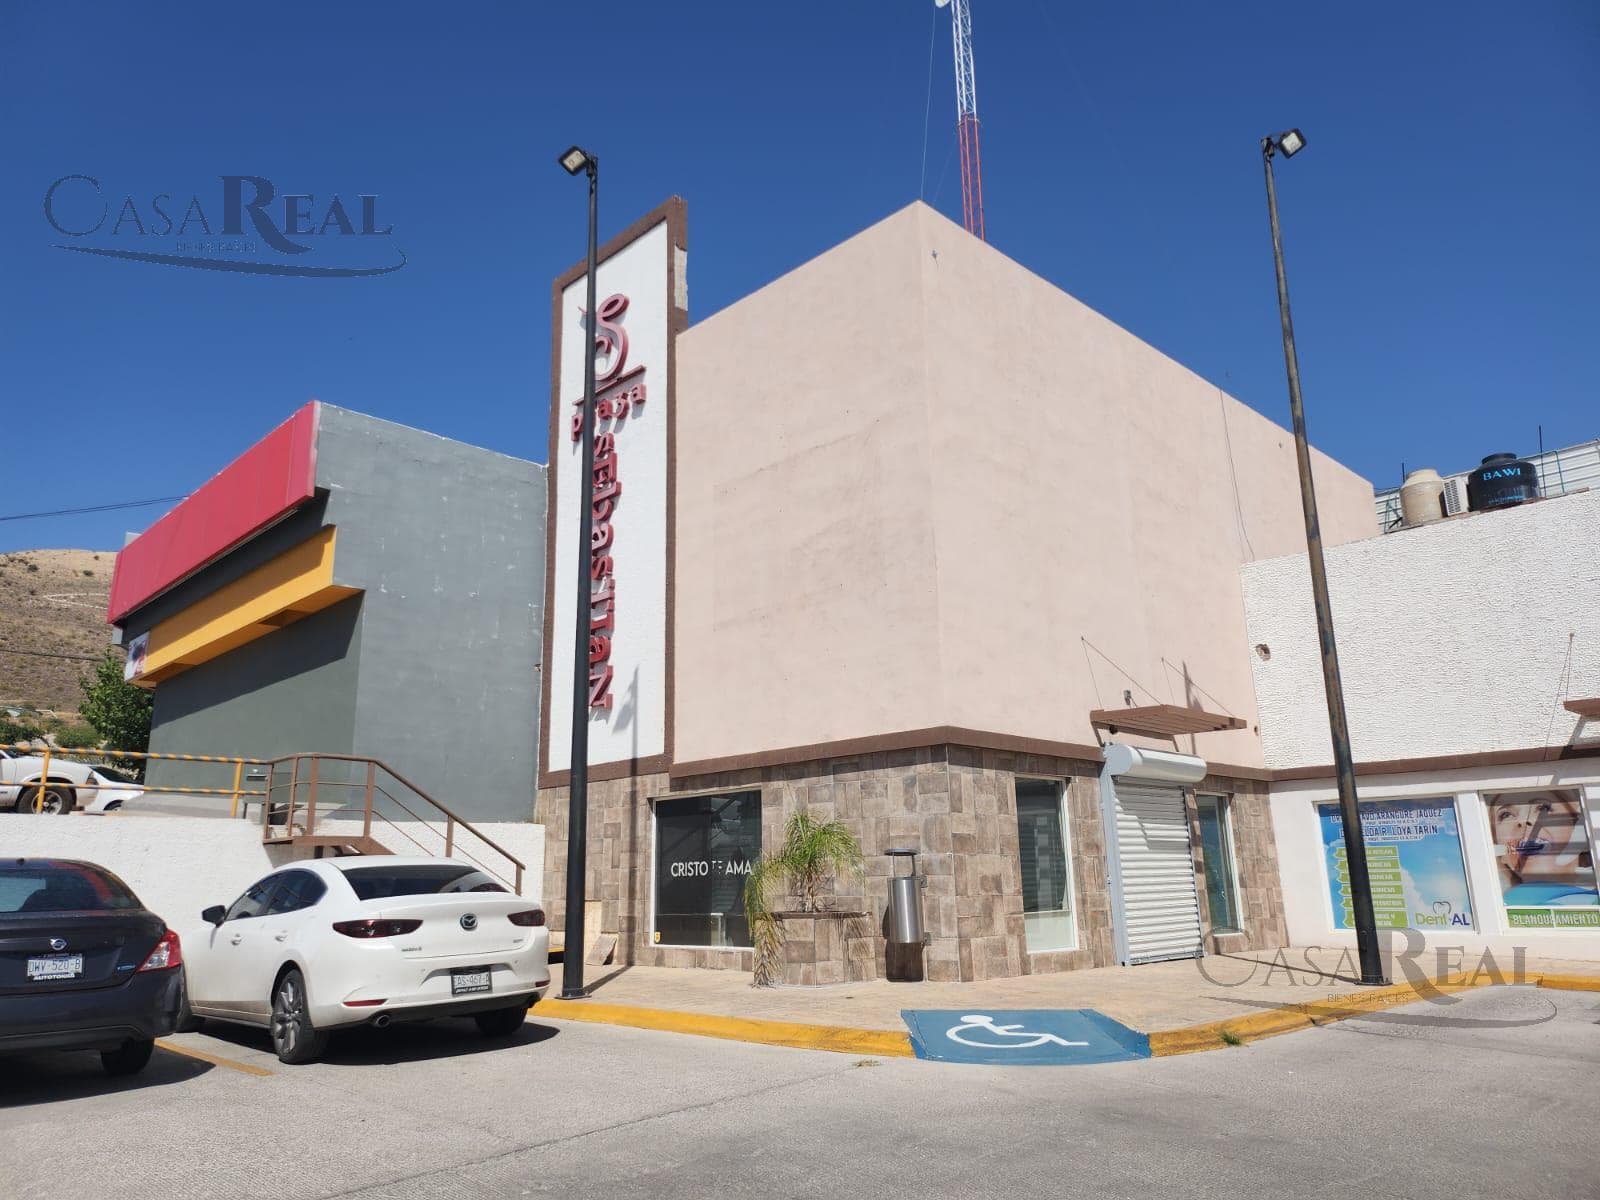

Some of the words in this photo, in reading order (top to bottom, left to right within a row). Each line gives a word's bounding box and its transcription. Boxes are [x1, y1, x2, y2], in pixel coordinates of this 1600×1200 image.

[1483, 467, 1521, 481] BAWI
[671, 861, 709, 877] CRISTO
[726, 859, 753, 876] AMA
